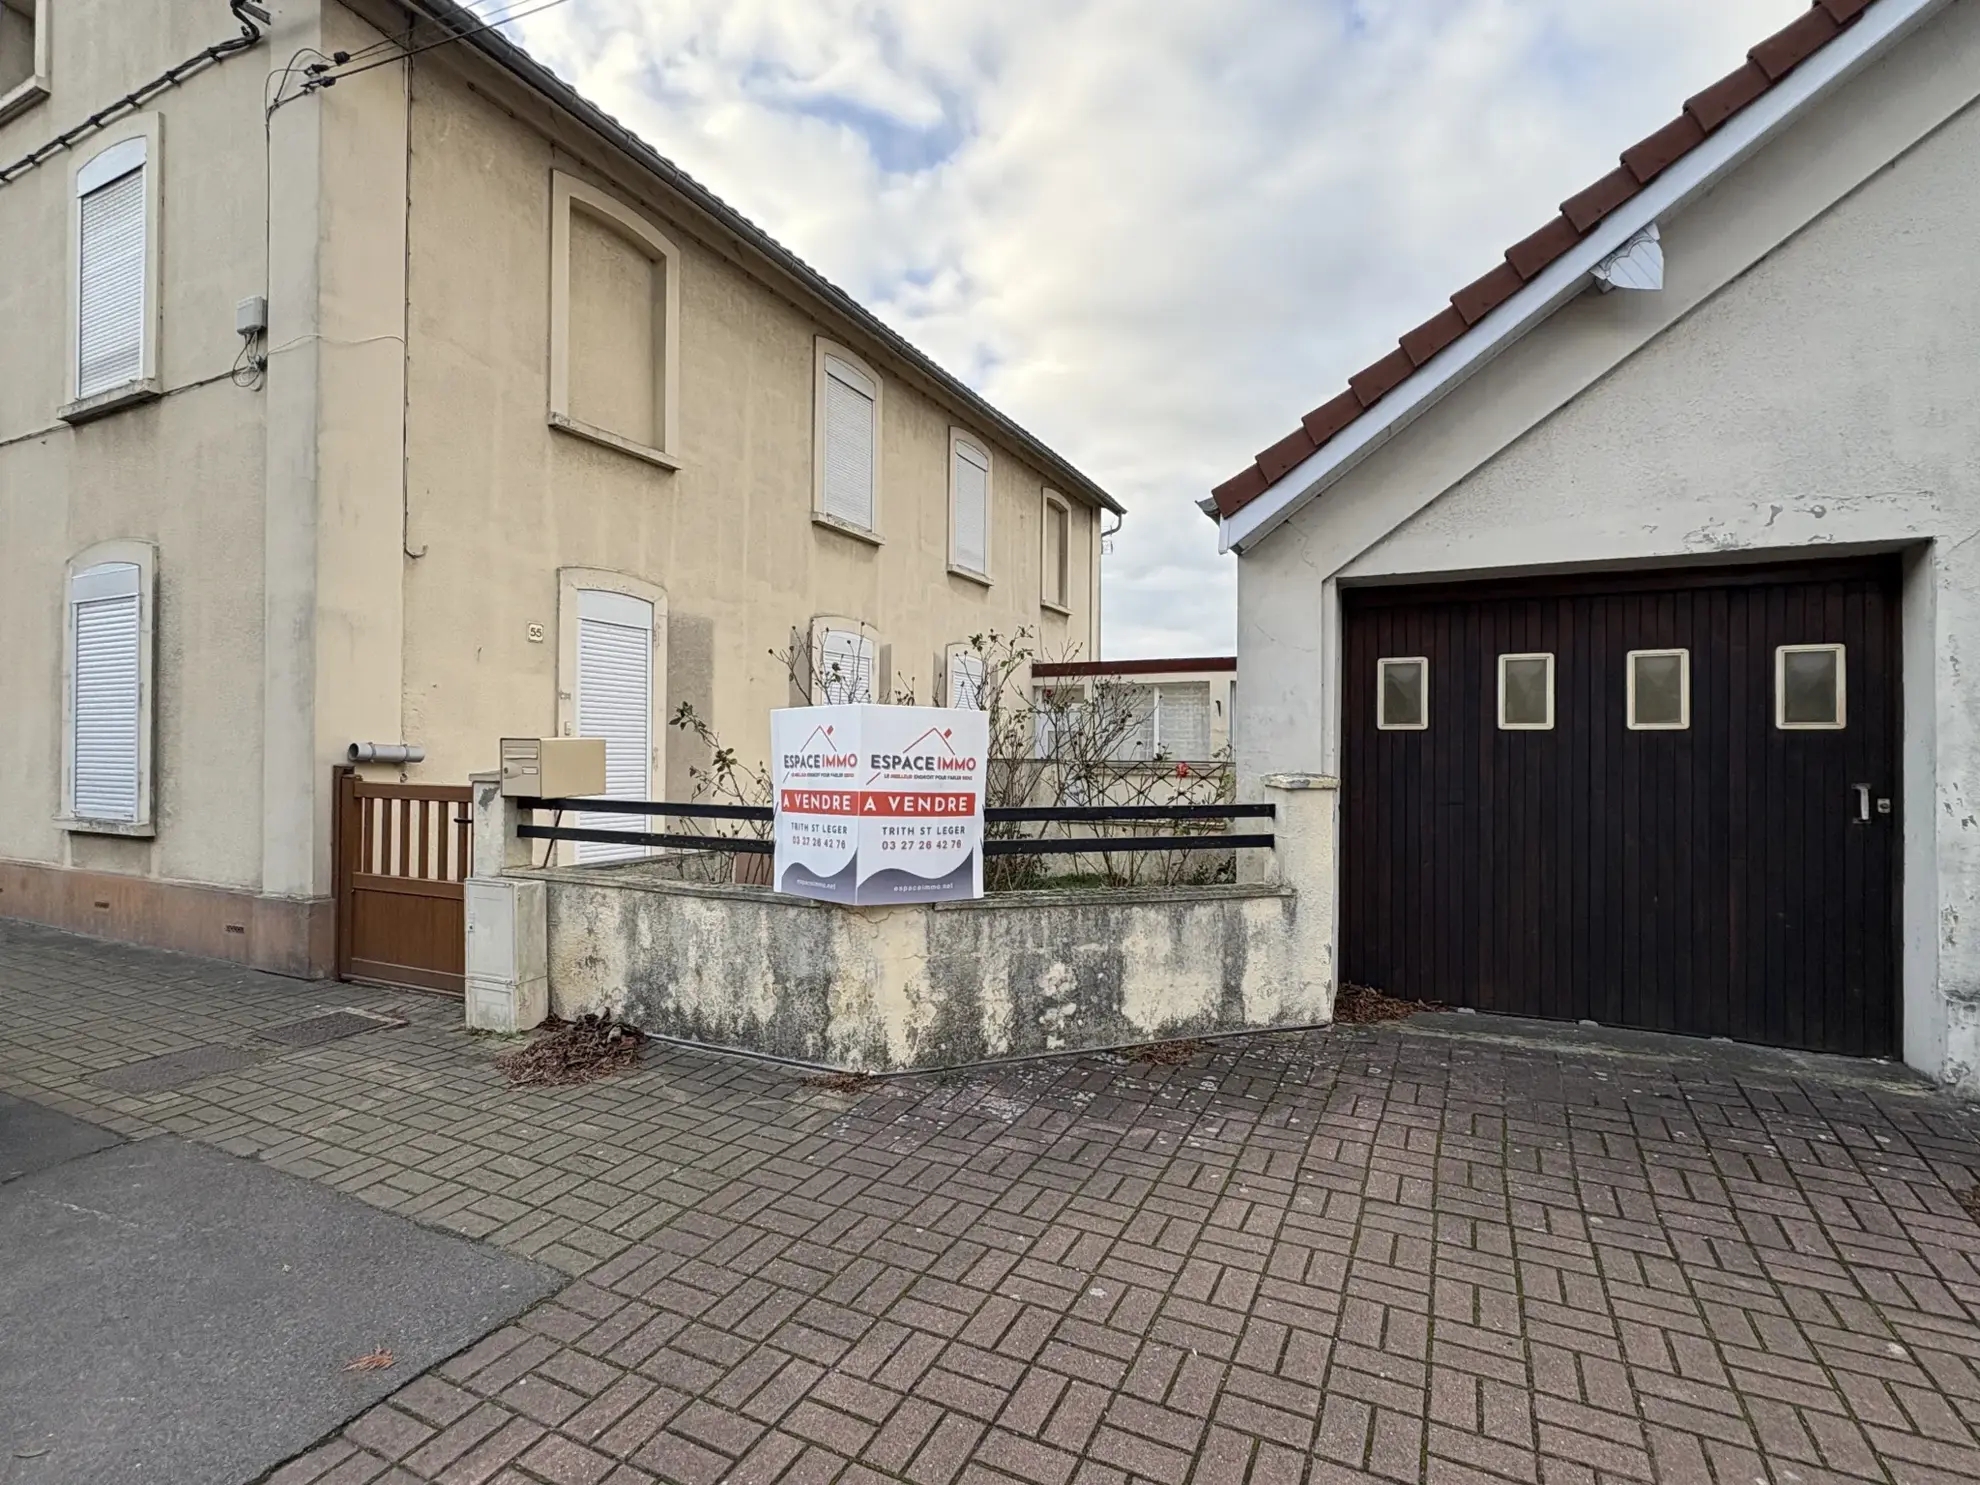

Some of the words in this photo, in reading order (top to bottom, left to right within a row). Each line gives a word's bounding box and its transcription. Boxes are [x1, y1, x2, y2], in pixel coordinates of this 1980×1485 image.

[530, 627, 542, 638] 55
[871, 754, 935, 771] ESPACE
[937, 756, 976, 771] IMMO
[783, 793, 790, 808] A
[794, 793, 852, 811] VENDRE
[864, 796, 877, 812] A
[888, 796, 968, 812] VENDRE
[791, 822, 809, 832] TRITH
[811, 824, 820, 832] ST
[822, 824, 848, 834] LEGER
[882, 826, 915, 836] TRITH
[920, 826, 932, 836] ST
[937, 825, 966, 835] LEGER
[793, 835, 801, 845] 03
[802, 836, 811, 846] 27
[824, 838, 834, 848] 42
[882, 841, 896, 850] 03
[901, 840, 914, 850] 27
[919, 840, 932, 850] 26
[936, 840, 948, 849] 42
[951, 839, 962, 849] 76
